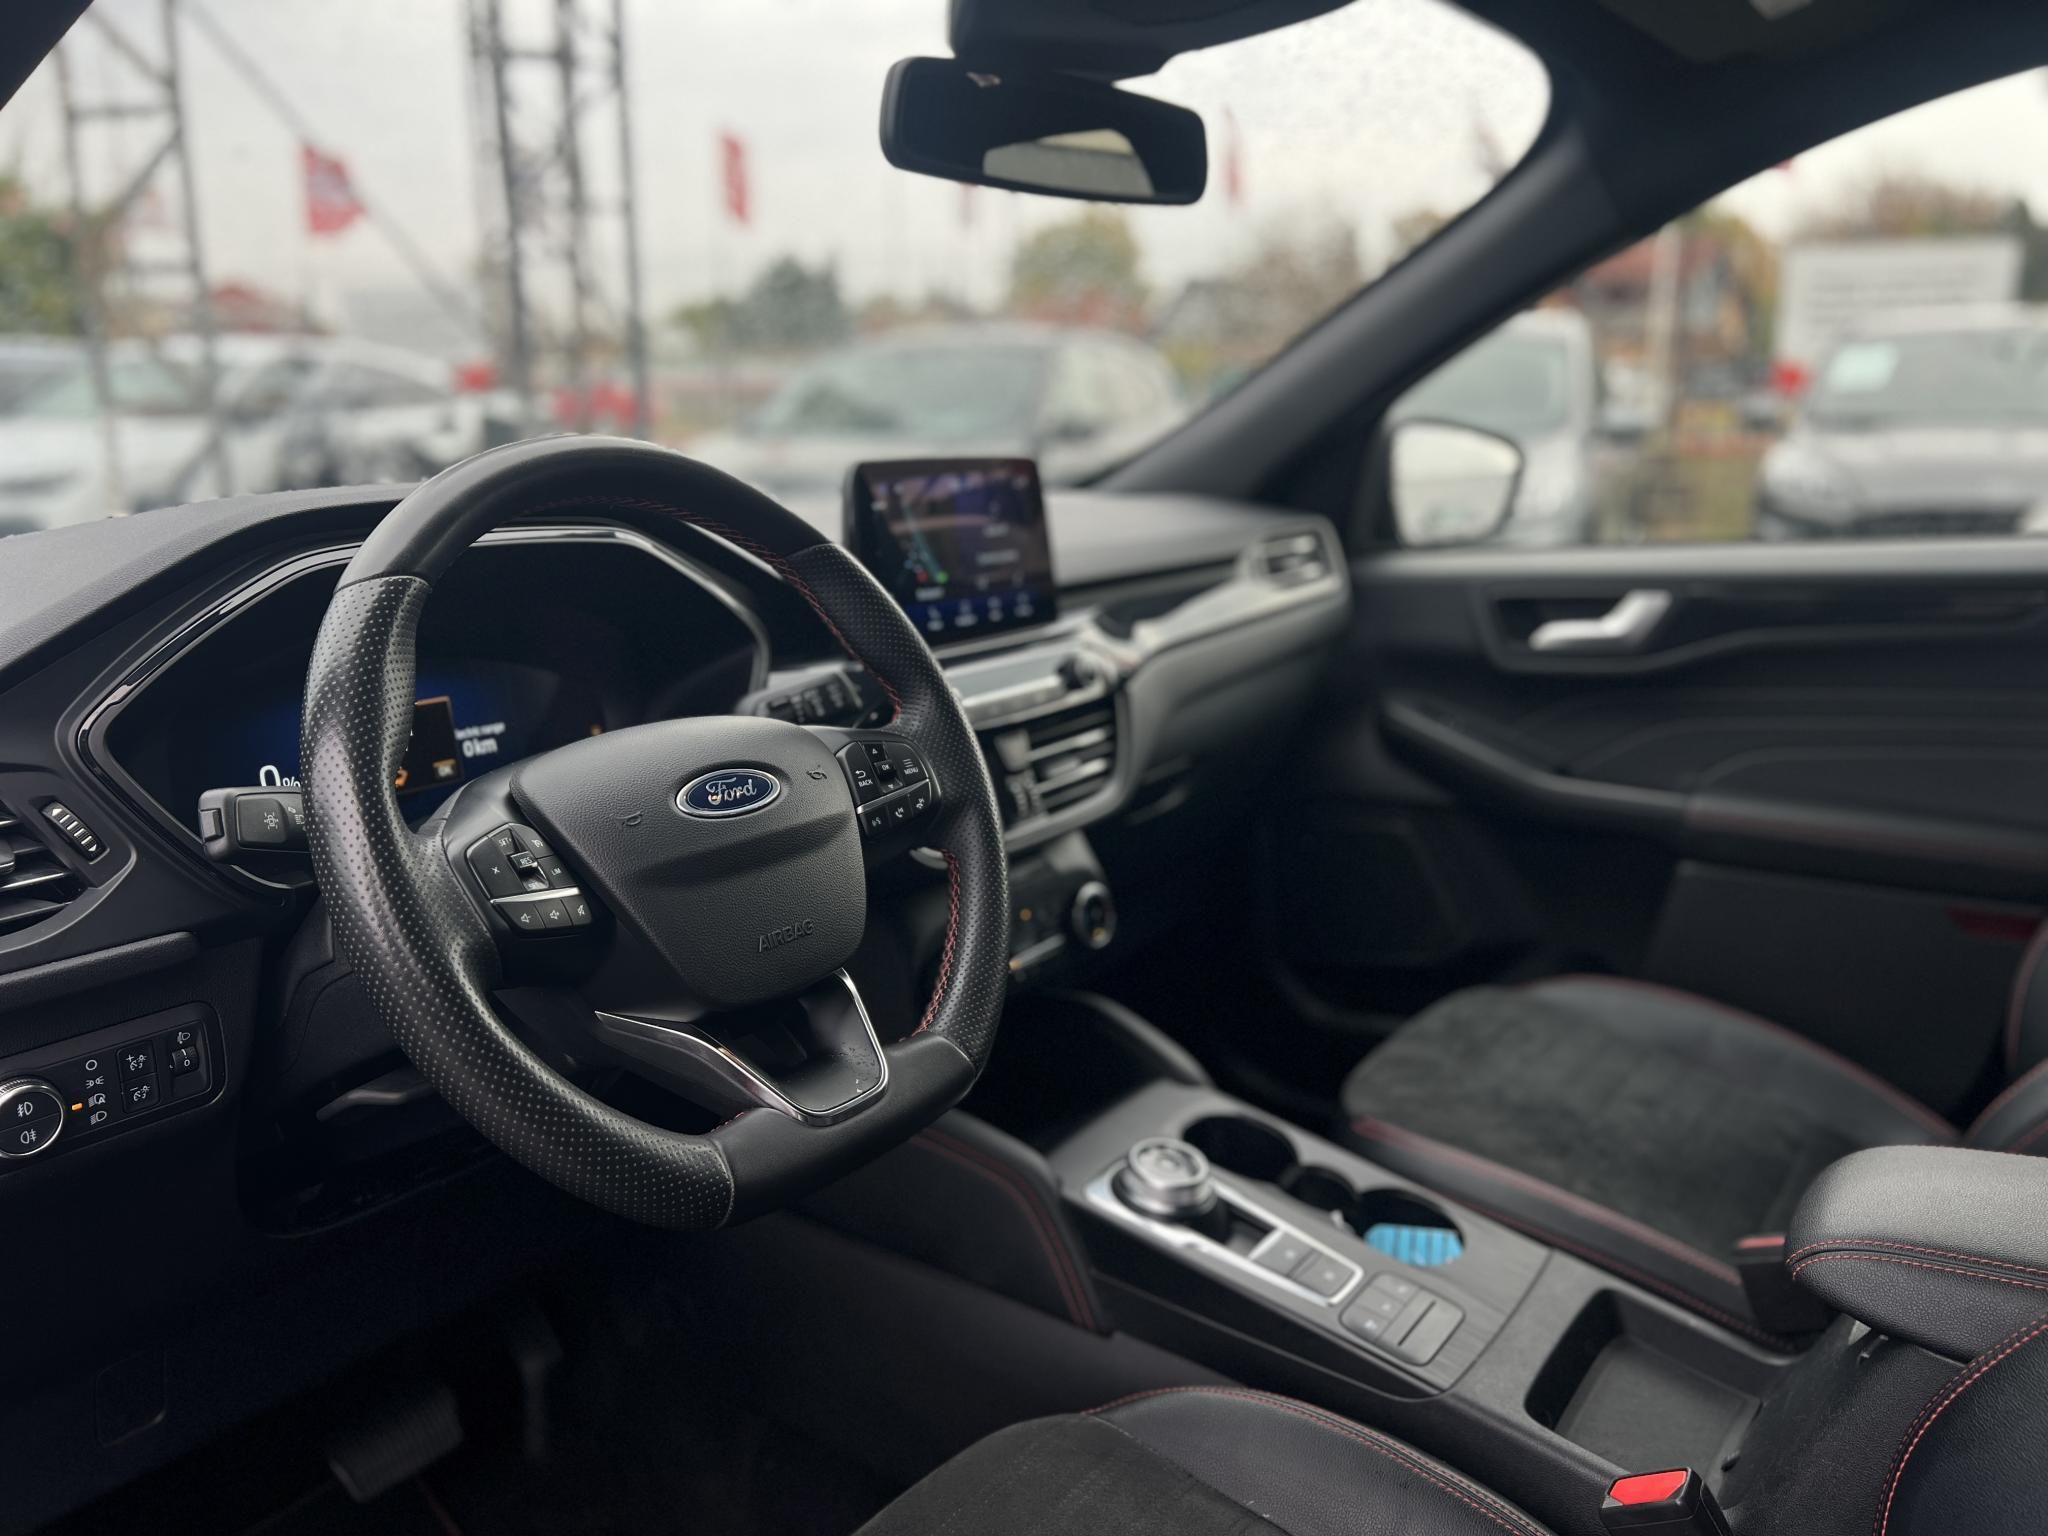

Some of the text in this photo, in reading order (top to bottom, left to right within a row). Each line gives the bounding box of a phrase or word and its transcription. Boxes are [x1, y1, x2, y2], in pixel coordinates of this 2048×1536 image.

[473, 738, 498, 756] km
[881, 764, 891, 772] OK
[904, 767, 919, 775] MENU
[858, 779, 873, 787] BACK
[705, 776, 757, 806] Ford
[519, 856, 533, 865] RES
[758, 920, 815, 952] AIRBAG
